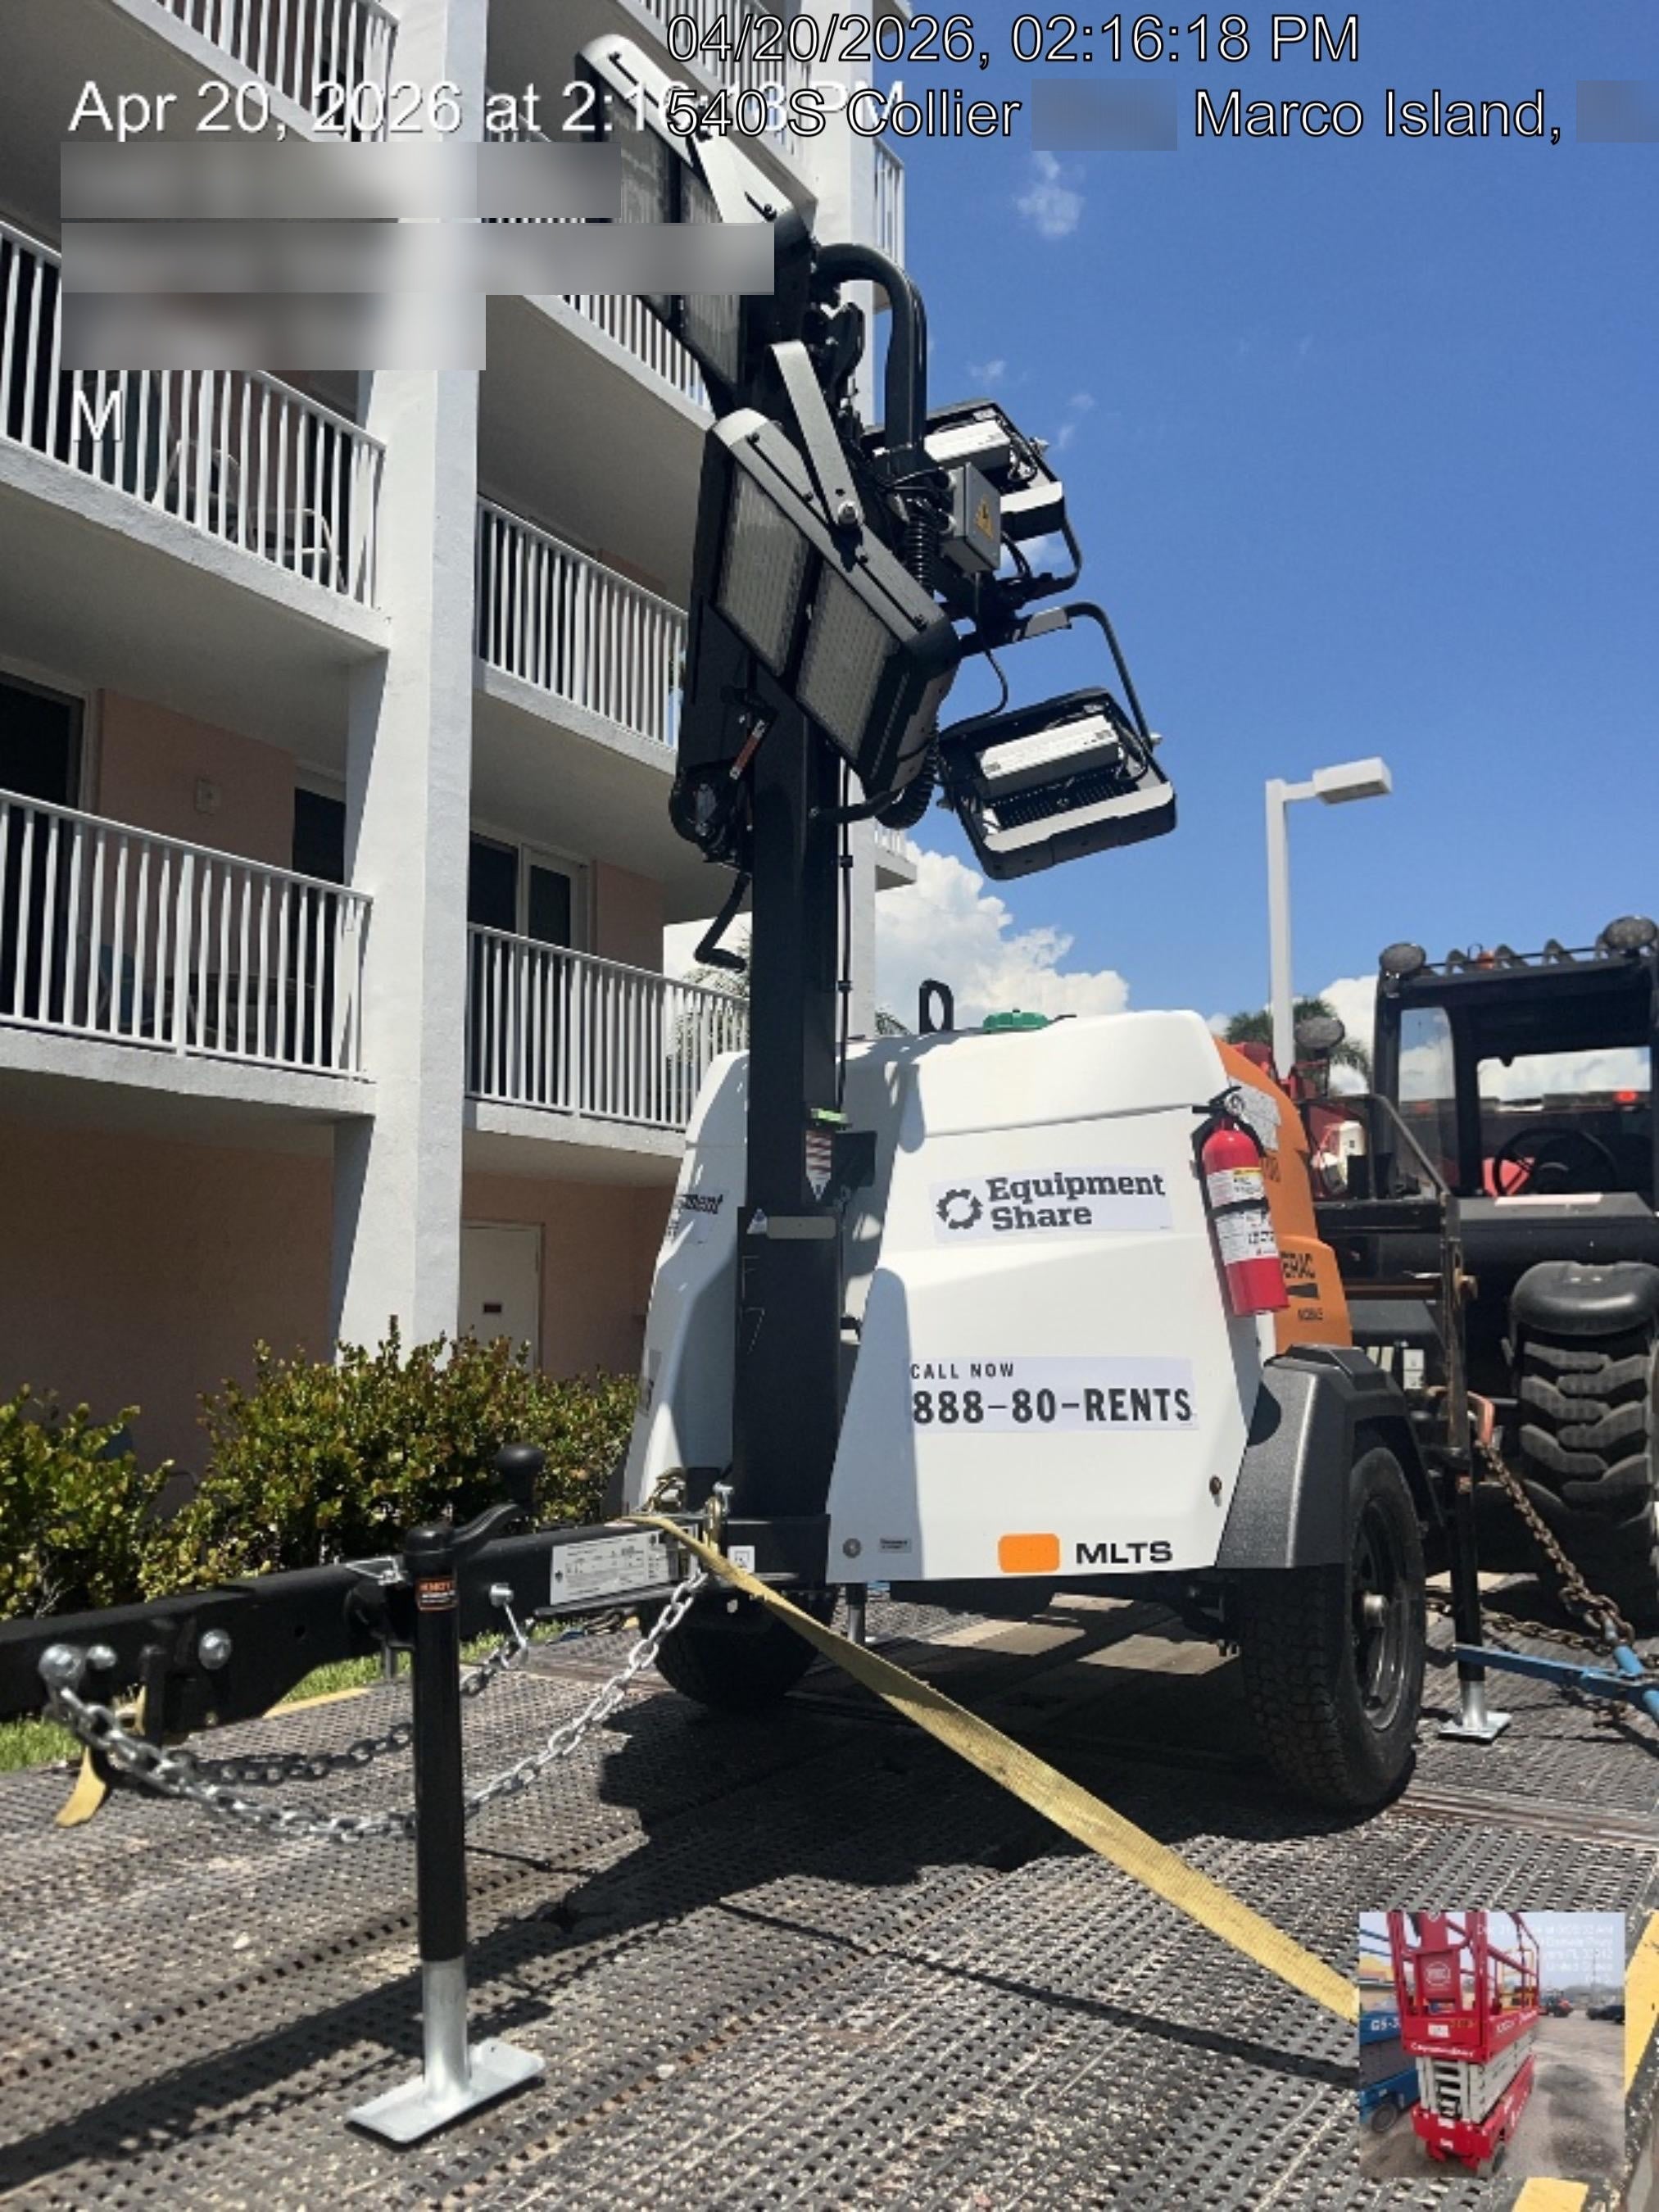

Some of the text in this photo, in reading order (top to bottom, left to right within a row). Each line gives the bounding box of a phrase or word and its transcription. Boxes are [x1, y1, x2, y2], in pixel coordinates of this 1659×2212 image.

[986, 1172, 1165, 1204] Equipment
[990, 1205, 1092, 1231] Share
[910, 1362, 1014, 1380] CALL NOW
[913, 1388, 1193, 1425] 888-80-RENTS
[1076, 1541, 1173, 1565] MLTS
